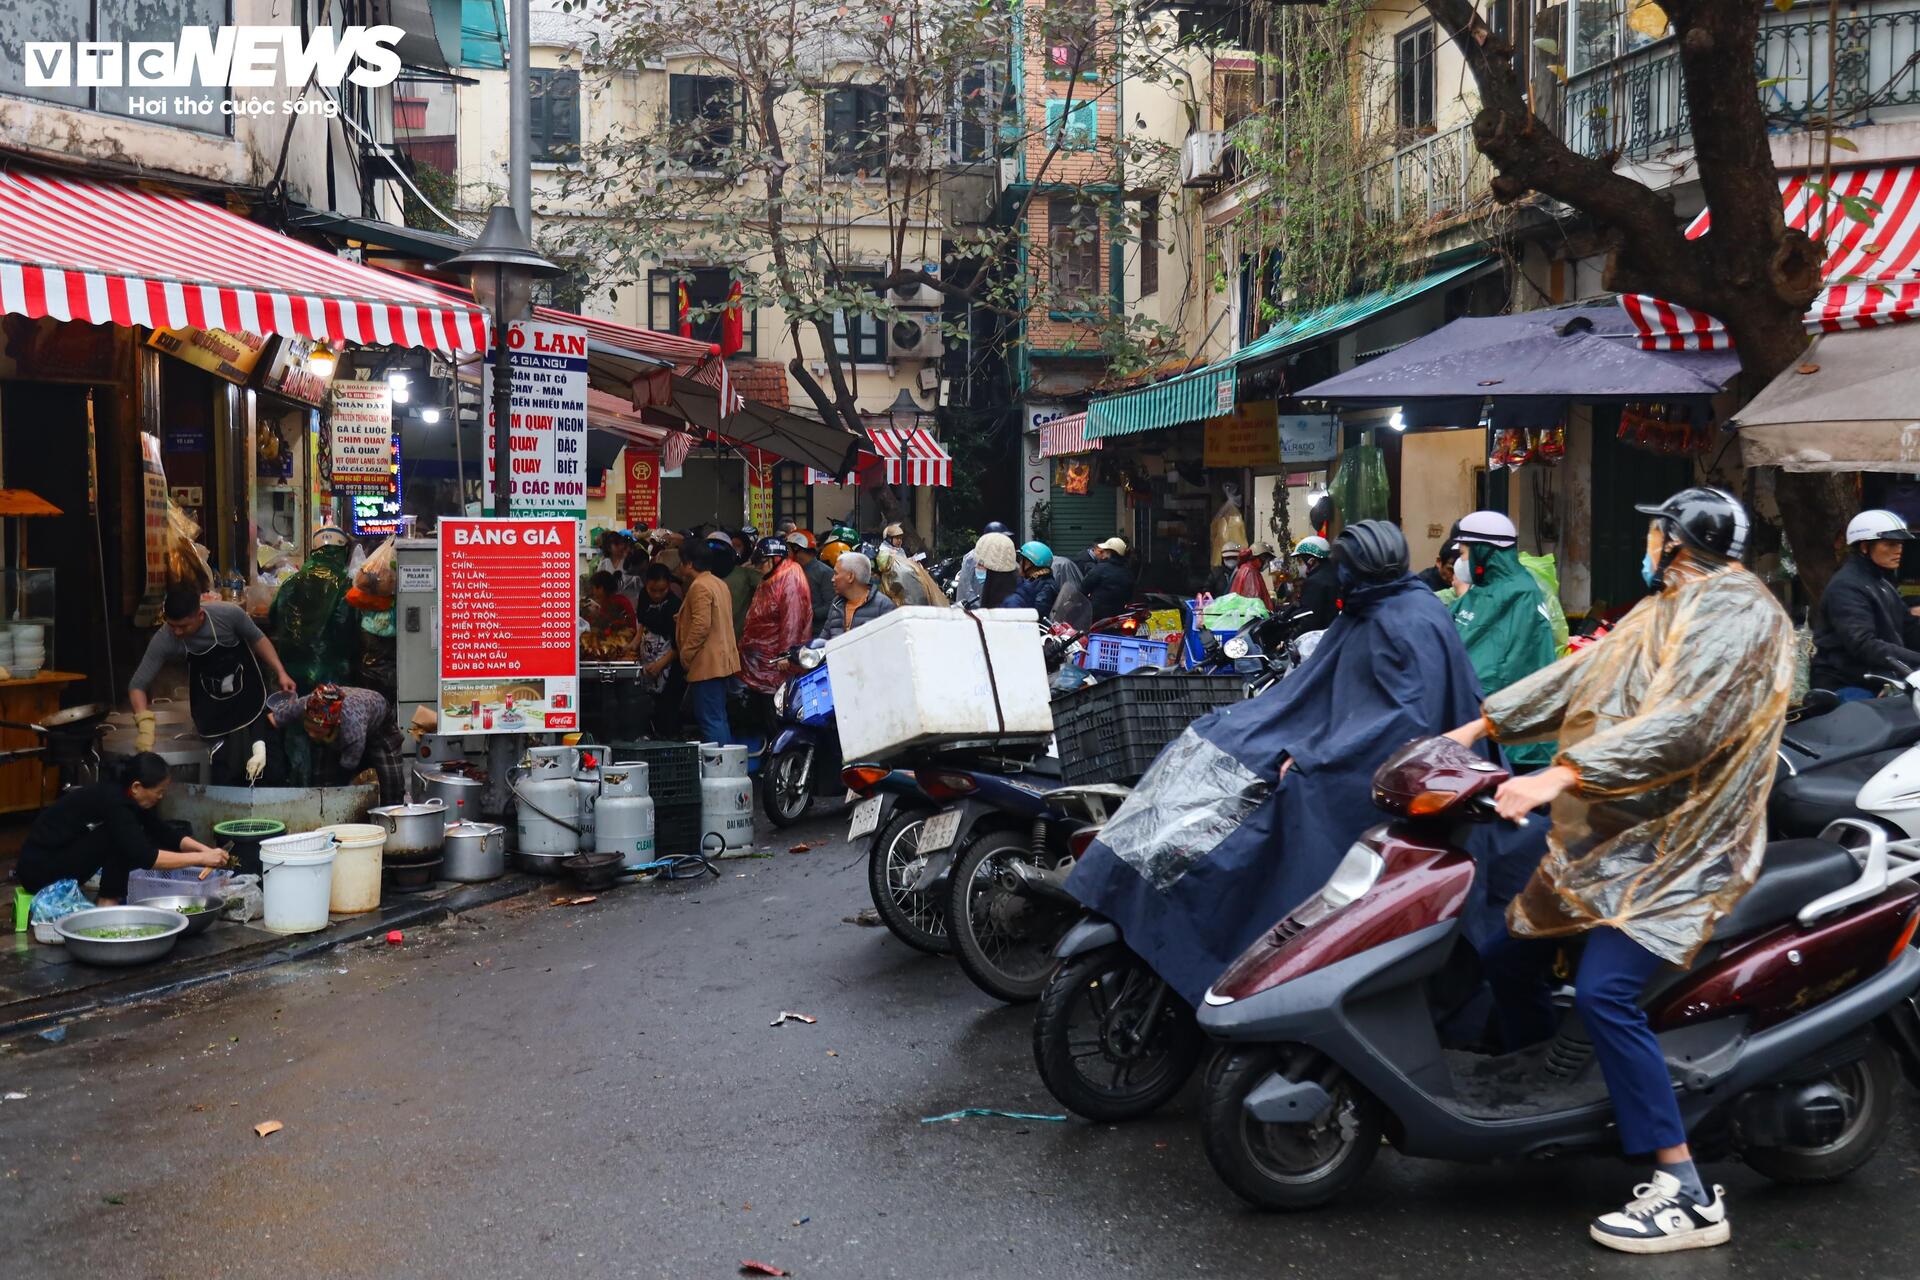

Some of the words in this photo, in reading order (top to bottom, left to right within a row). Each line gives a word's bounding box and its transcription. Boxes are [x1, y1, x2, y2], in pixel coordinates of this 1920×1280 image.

[534, 332, 586, 356] LAN
[521, 356, 540, 366] GIA
[525, 414, 553, 430] QUAY
[558, 417, 584, 432] NGON
[510, 436, 538, 452] QUAY
[558, 436, 577, 456] ĐẶC
[513, 458, 541, 474] QUAY
[558, 457, 578, 477] BIỆT
[522, 479, 550, 494] CÁC
[554, 480, 583, 495] MÓN
[454, 524, 517, 545] BẢNG
[523, 526, 561, 545] GIÁ
[452, 571, 465, 579] TÁI
[452, 642, 471, 650] CƠM
[452, 651, 465, 660] TÁI
[452, 662, 470, 670] BÚN
[509, 660, 520, 670] BỘ
